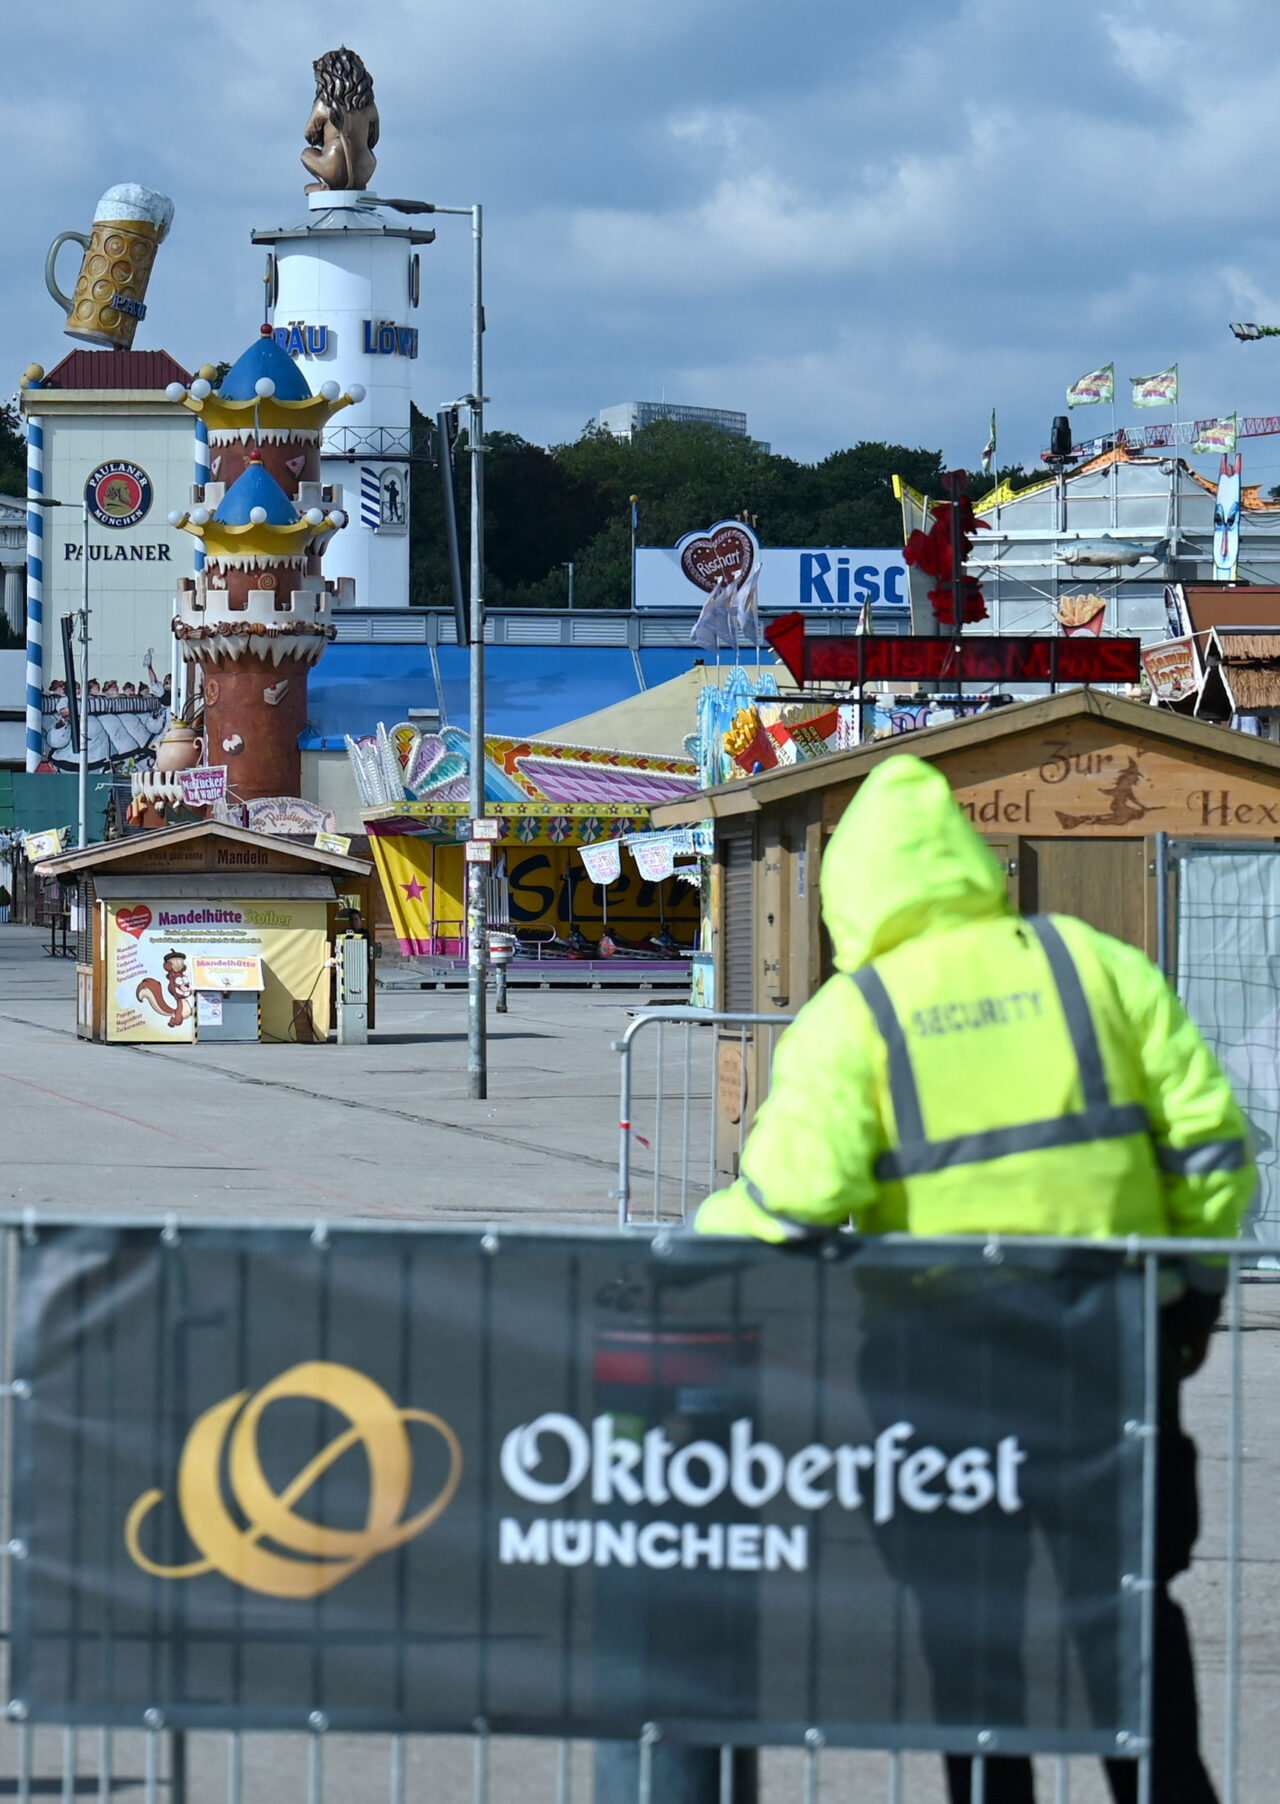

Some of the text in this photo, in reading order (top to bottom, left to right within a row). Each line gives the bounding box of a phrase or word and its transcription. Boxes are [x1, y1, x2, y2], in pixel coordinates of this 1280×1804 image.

[89, 463, 148, 487] PAULANER
[94, 508, 143, 526] MÜNCHEN
[64, 543, 173, 561] PAULANER
[696, 549, 741, 577] Rischart
[1039, 741, 1113, 783] Zur
[218, 849, 268, 865] Mandeln
[159, 909, 242, 926] Mandelhütte
[244, 911, 292, 926] Stoiber
[913, 990, 1044, 1037] SECURITY
[499, 1411, 1027, 1525] Oktoberfest
[498, 1517, 809, 1572] MÜNCHEN
